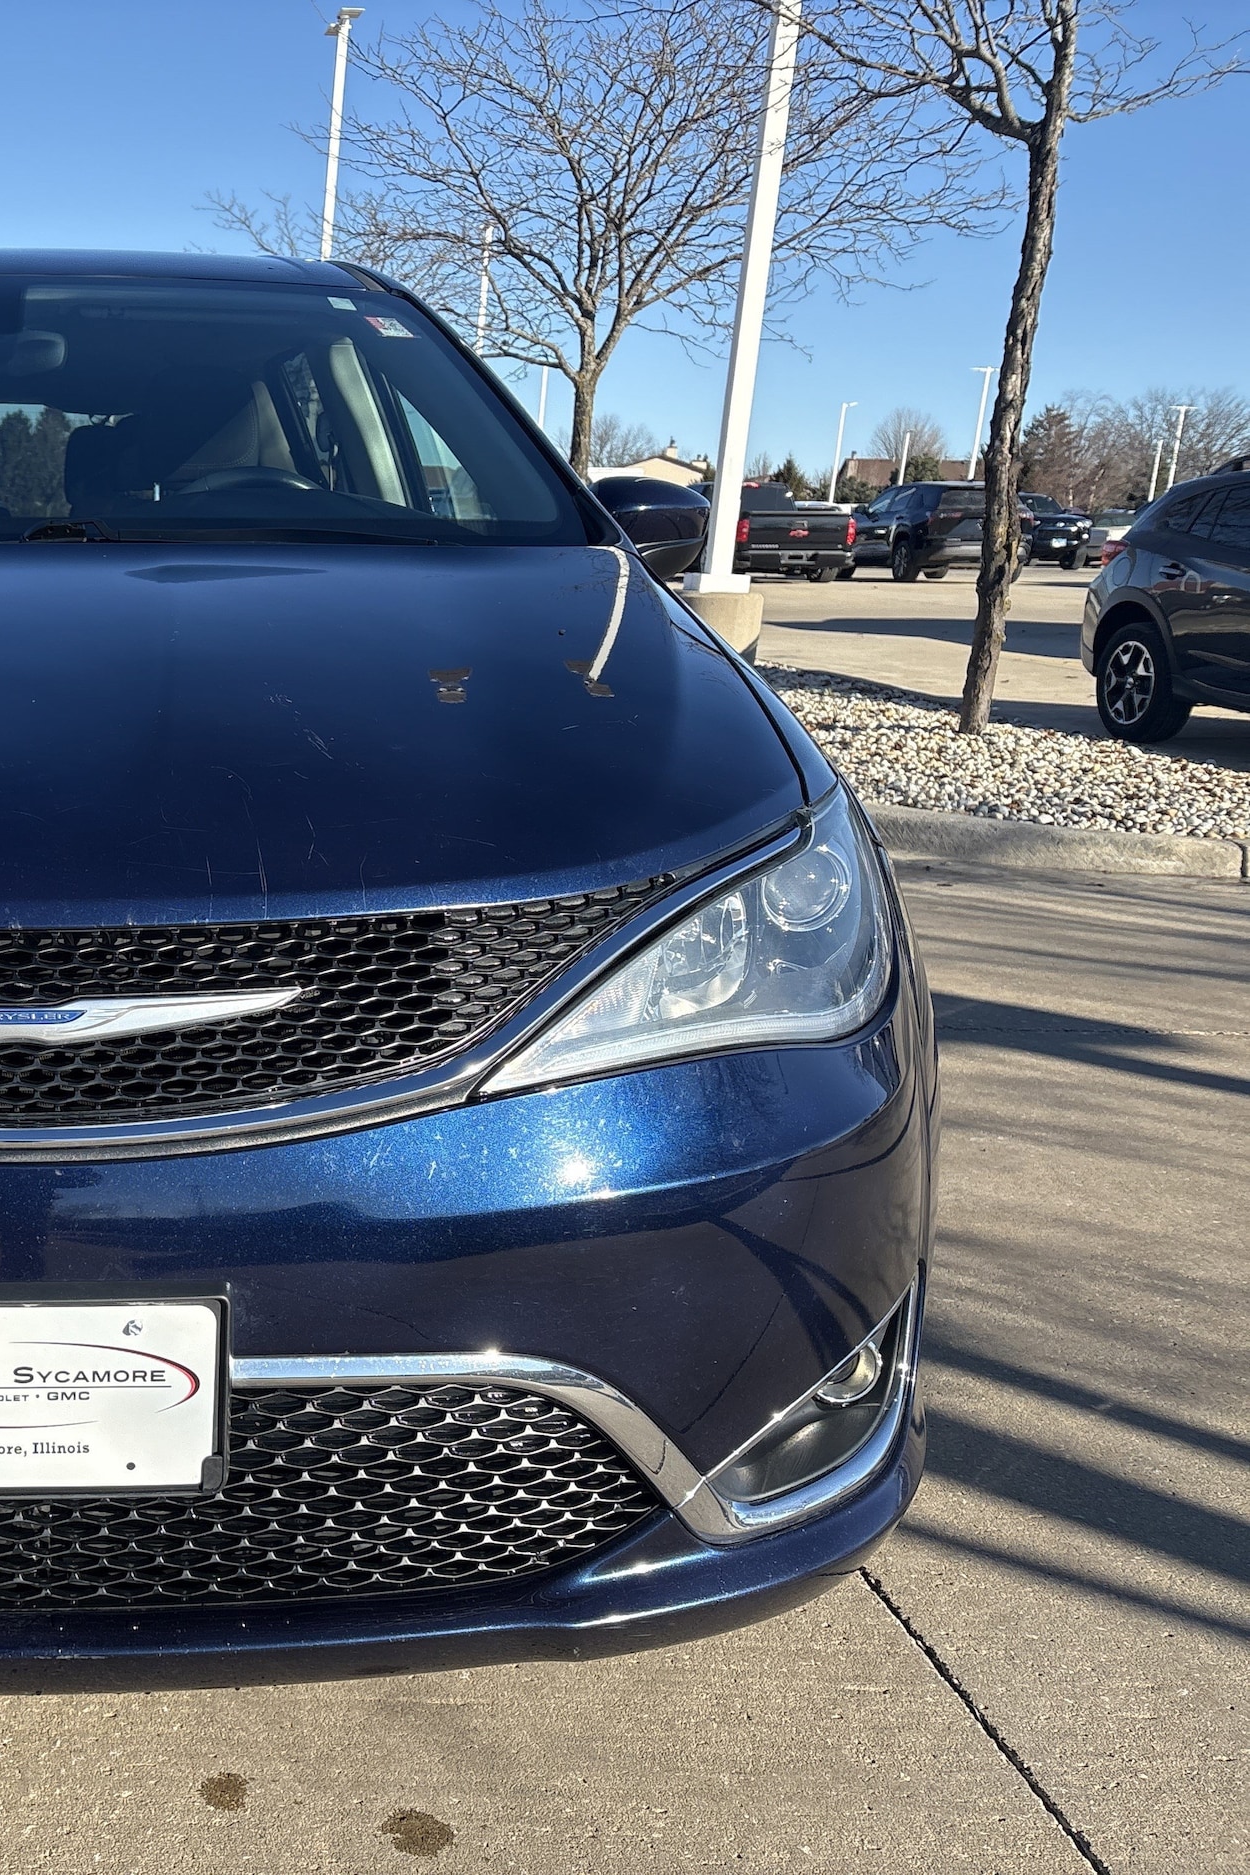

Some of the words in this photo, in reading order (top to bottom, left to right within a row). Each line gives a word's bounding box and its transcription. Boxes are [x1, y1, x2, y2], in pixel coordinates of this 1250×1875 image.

[13, 1366, 166, 1383] SYCAMORE
[47, 1391, 90, 1401] GMC
[33, 1441, 90, 1455] Illinois
